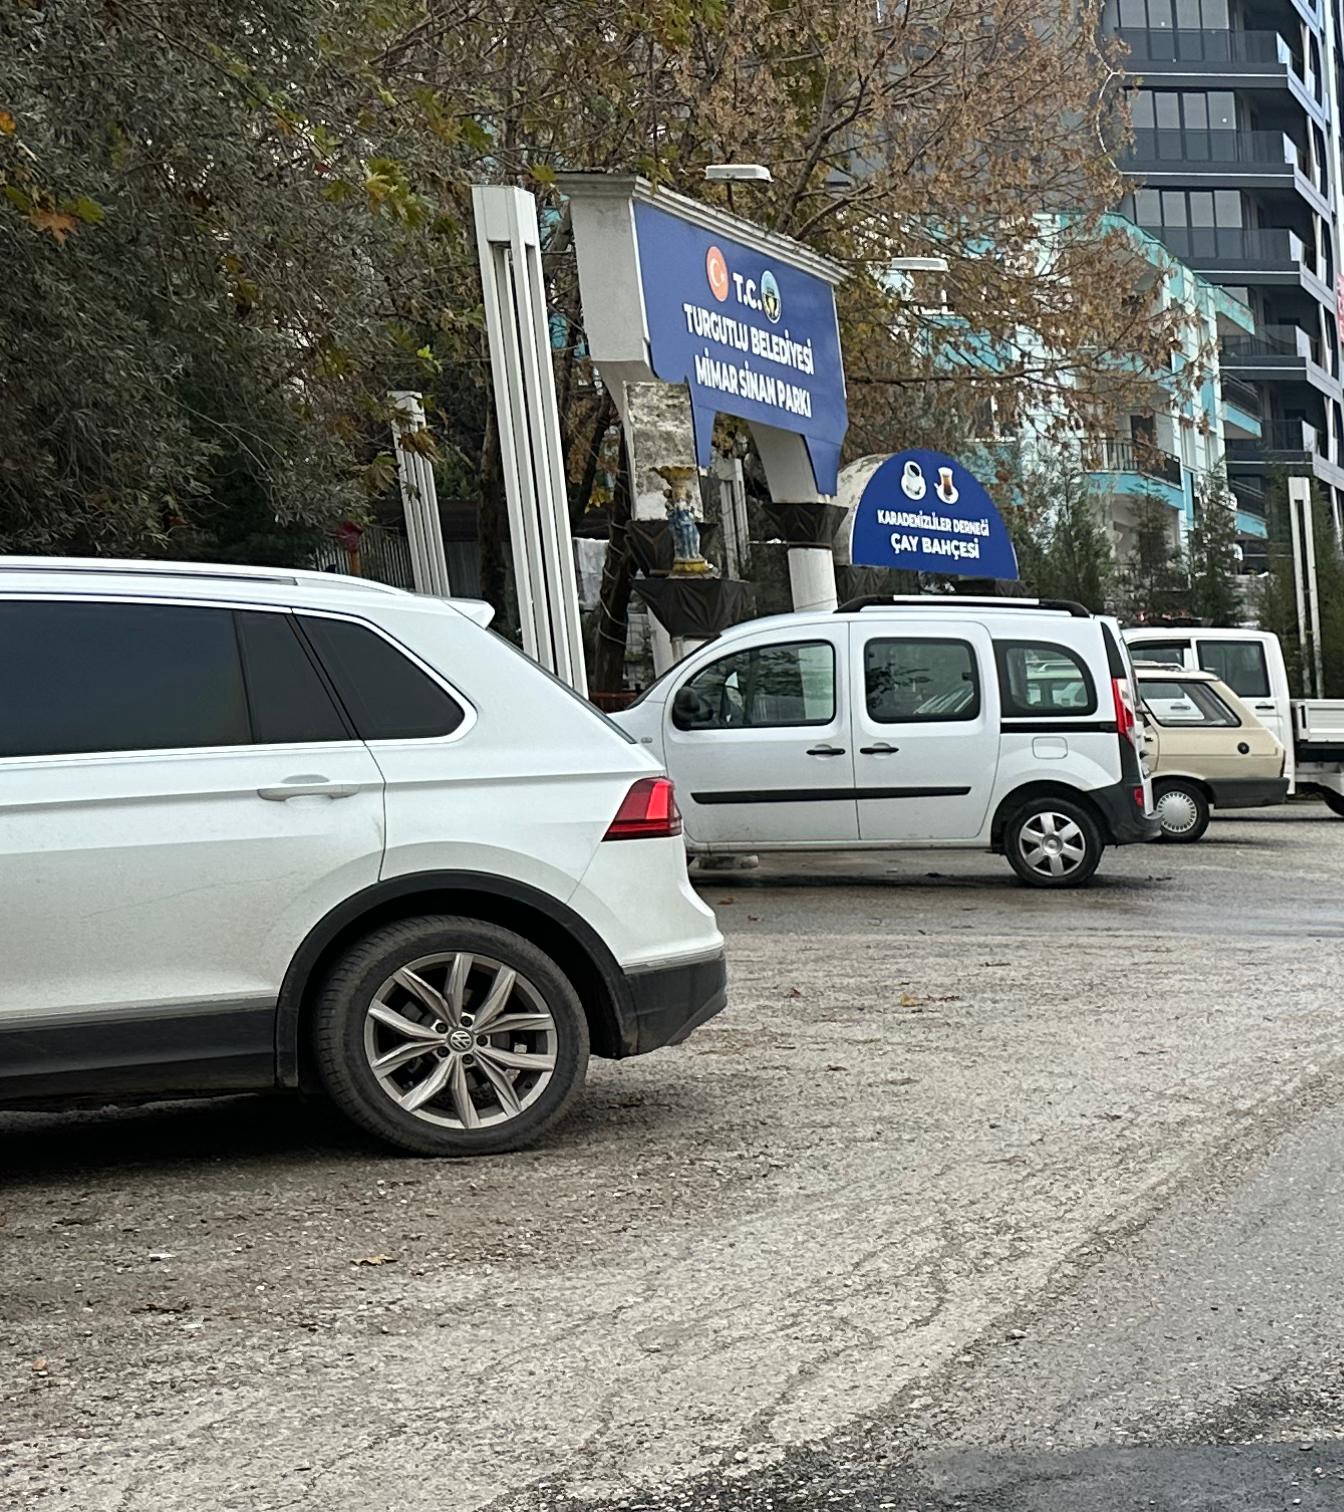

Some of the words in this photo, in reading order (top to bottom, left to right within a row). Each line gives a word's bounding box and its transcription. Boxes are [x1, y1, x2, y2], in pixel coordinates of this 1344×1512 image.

[732, 272, 762, 311] T.C.
[683, 303, 748, 352] TURGUTLU
[750, 329, 815, 375] BELEDİYESİ
[694, 347, 739, 395] MİMAR
[738, 361, 778, 406] SİNAN
[776, 379, 812, 418] PARKI
[877, 509, 952, 533] KARADENİZLİLER
[952, 518, 990, 537] DERNEĞİ
[890, 532, 919, 554] ÇAY
[921, 537, 980, 561] BAHÇESİ
